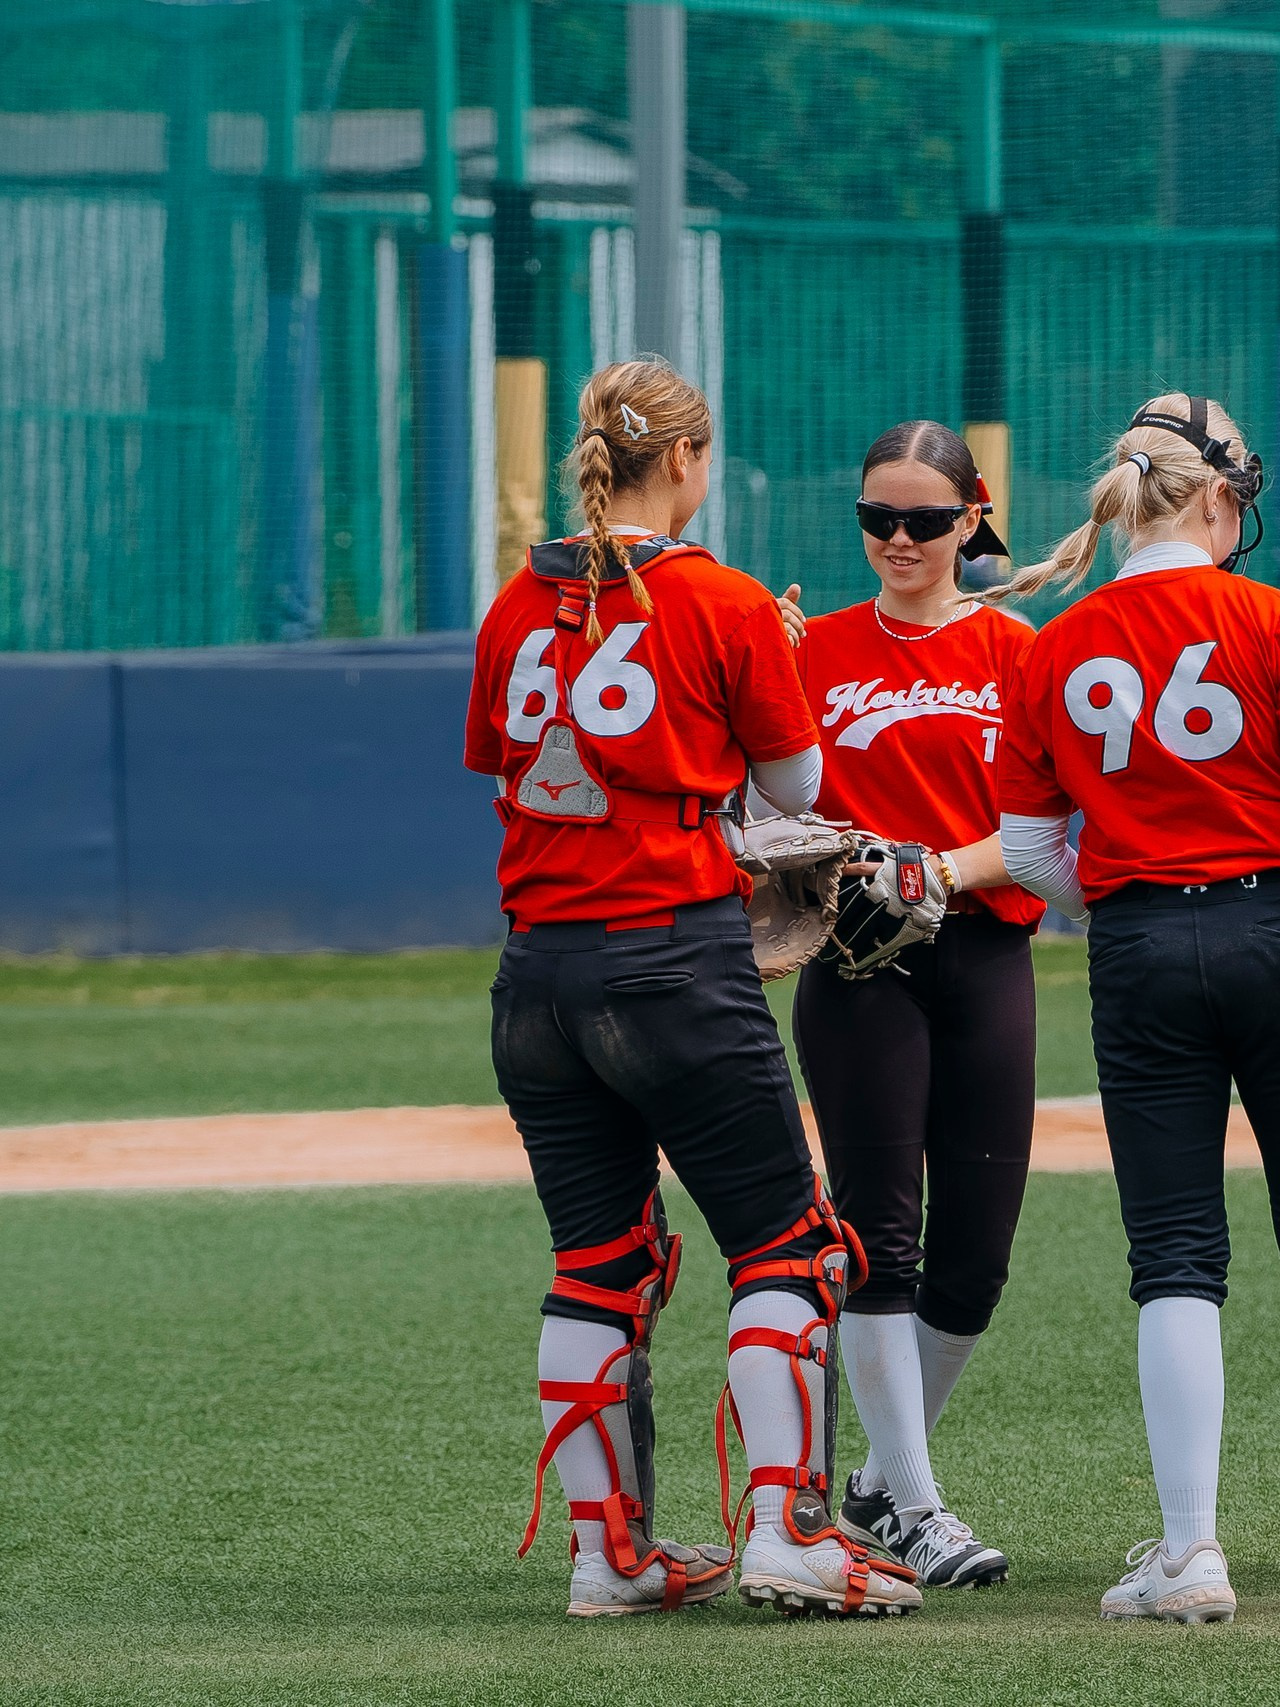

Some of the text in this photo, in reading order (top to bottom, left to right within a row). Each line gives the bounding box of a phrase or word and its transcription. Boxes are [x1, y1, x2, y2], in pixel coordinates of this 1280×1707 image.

[504, 620, 658, 744] 66
[1063, 640, 1245, 776] 96
[982, 727, 1002, 763] 1
